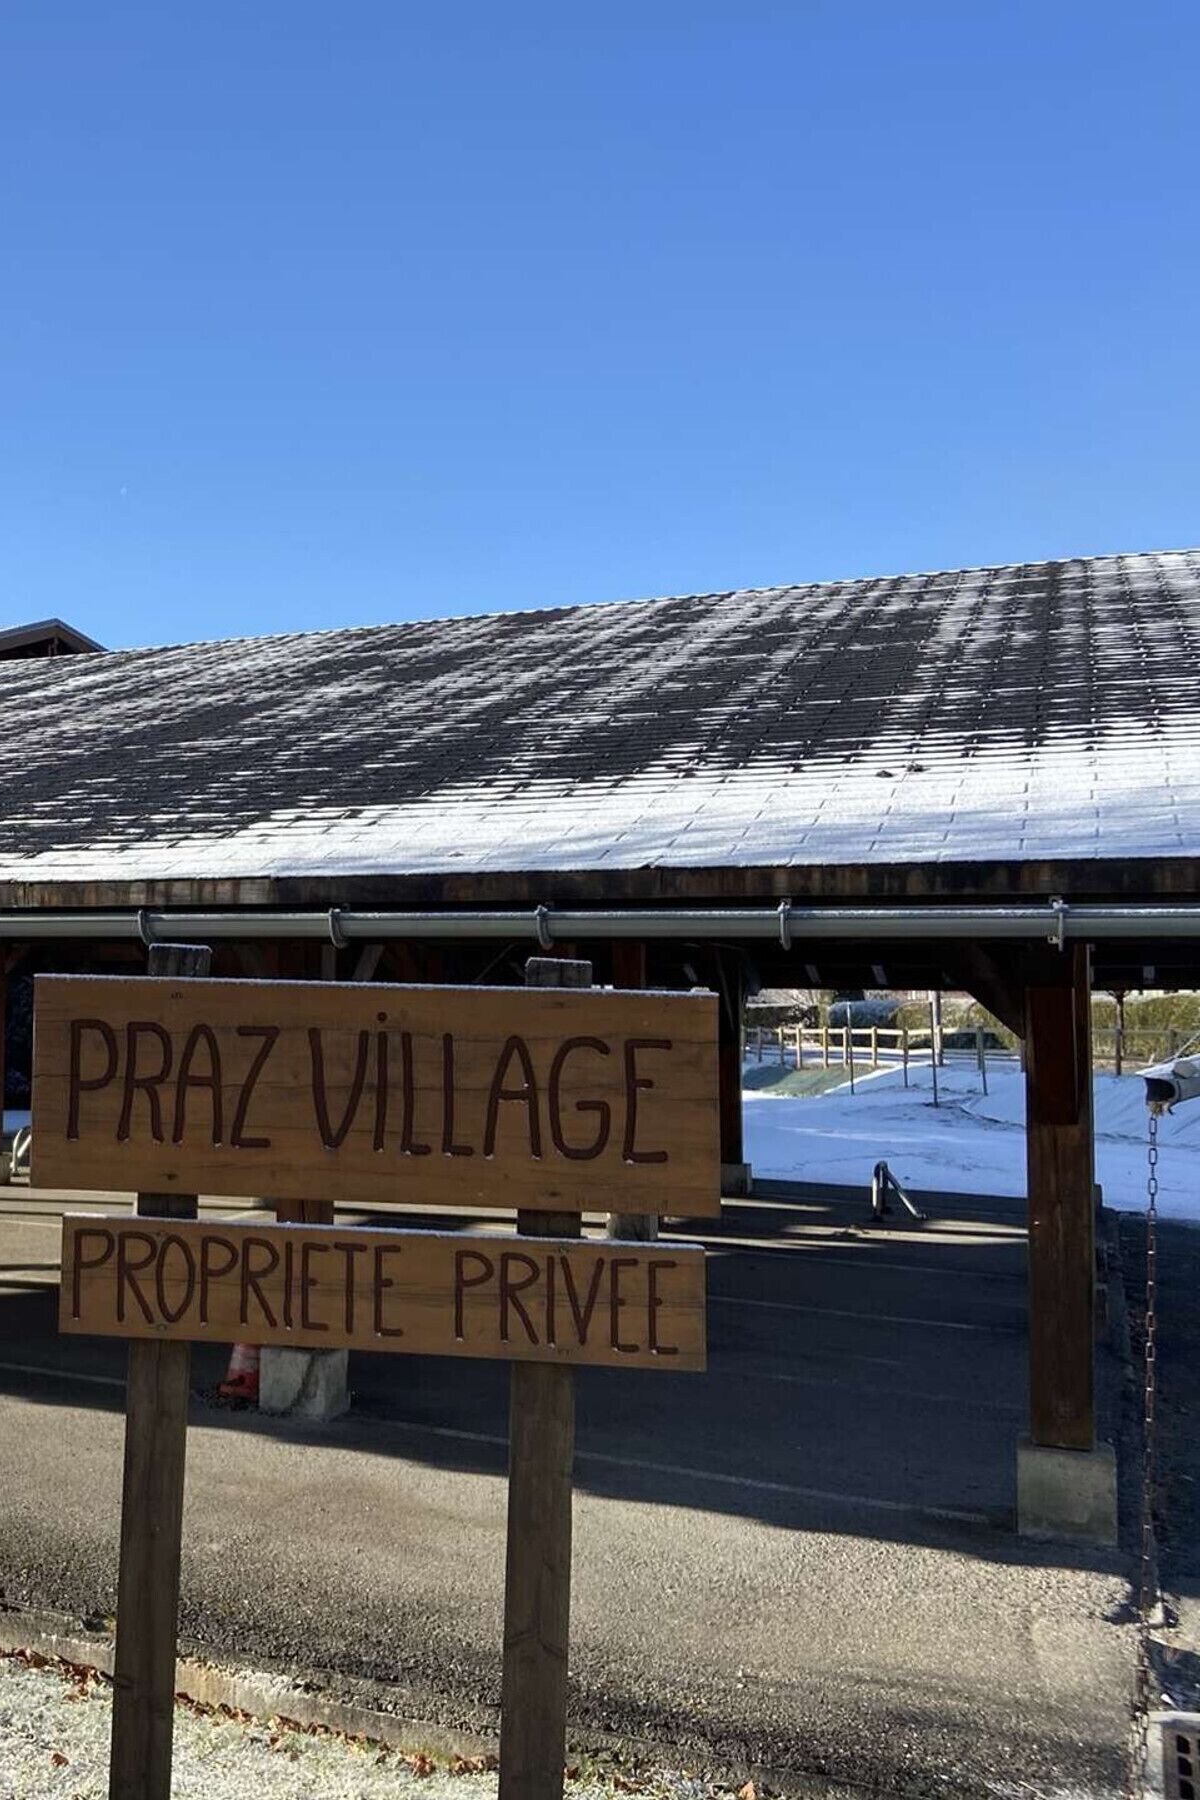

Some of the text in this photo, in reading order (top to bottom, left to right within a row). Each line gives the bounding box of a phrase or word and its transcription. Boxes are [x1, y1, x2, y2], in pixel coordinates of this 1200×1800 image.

[67, 1011, 673, 1163] PRAZ VILLAGE
[72, 1228, 678, 1354] PROPRIETE PRIVEE
